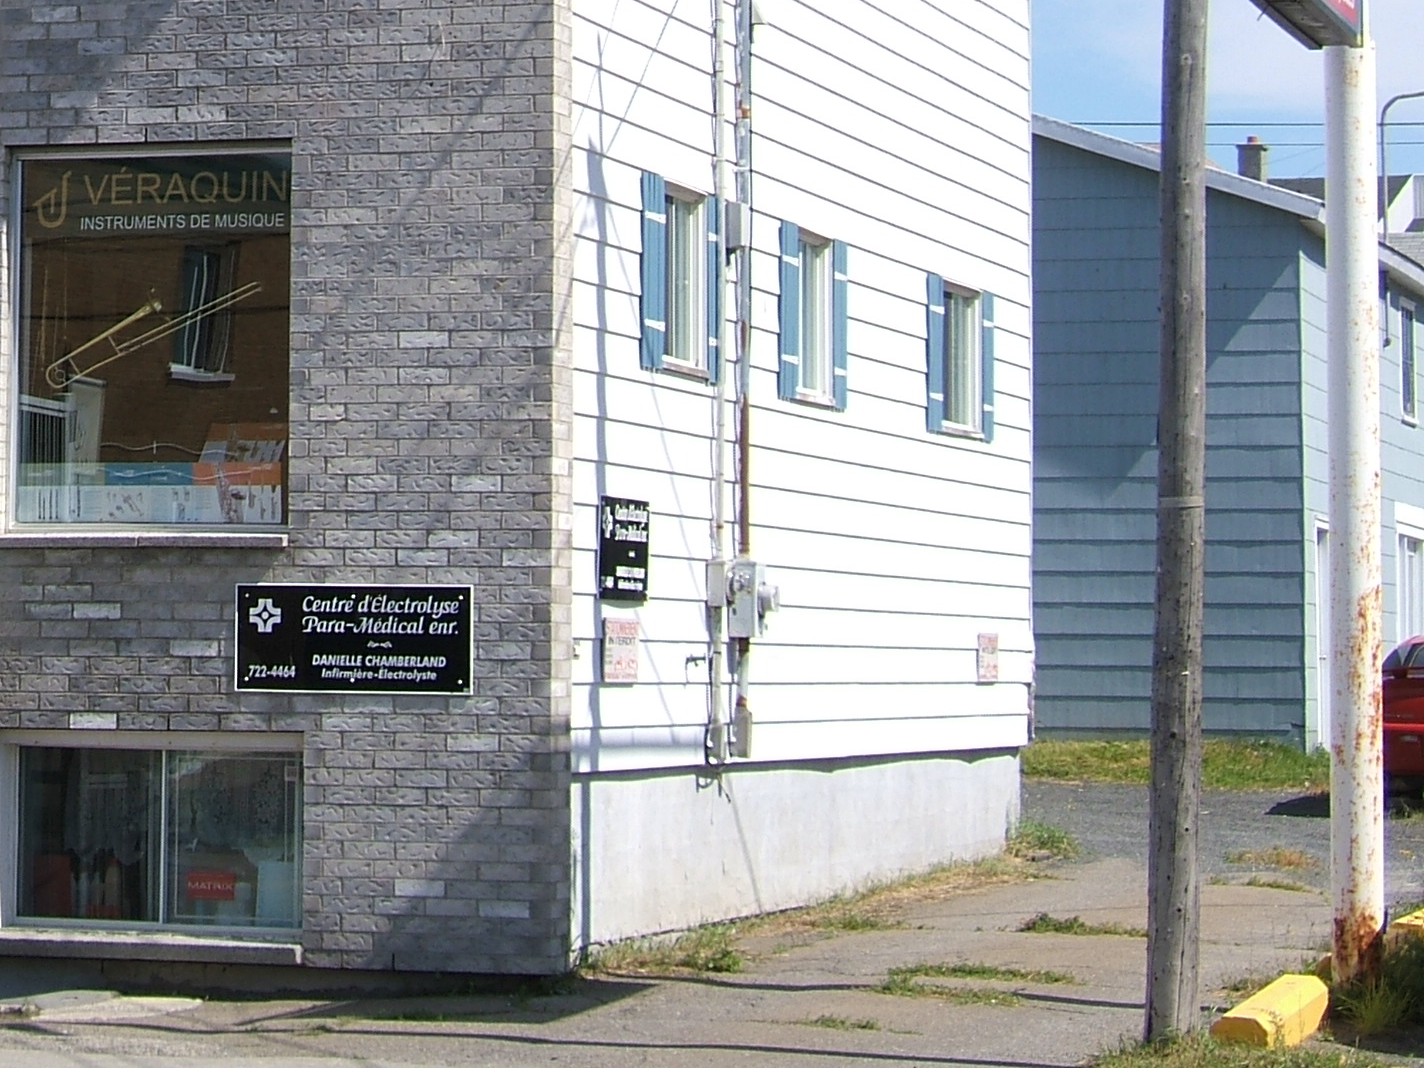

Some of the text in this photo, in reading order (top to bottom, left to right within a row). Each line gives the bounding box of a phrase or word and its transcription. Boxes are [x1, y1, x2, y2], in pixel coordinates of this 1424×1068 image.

[84, 166, 287, 206] VÉRAQUIN
[80, 212, 285, 230] INSTRUMENTS DE MUSIQUE
[302, 594, 460, 618] Centre d'Électrolyse
[302, 615, 459, 634] Para-Médical enr.
[312, 654, 447, 668] DANIELLE CHAMBERLAND
[248, 665, 296, 679] 722-4464
